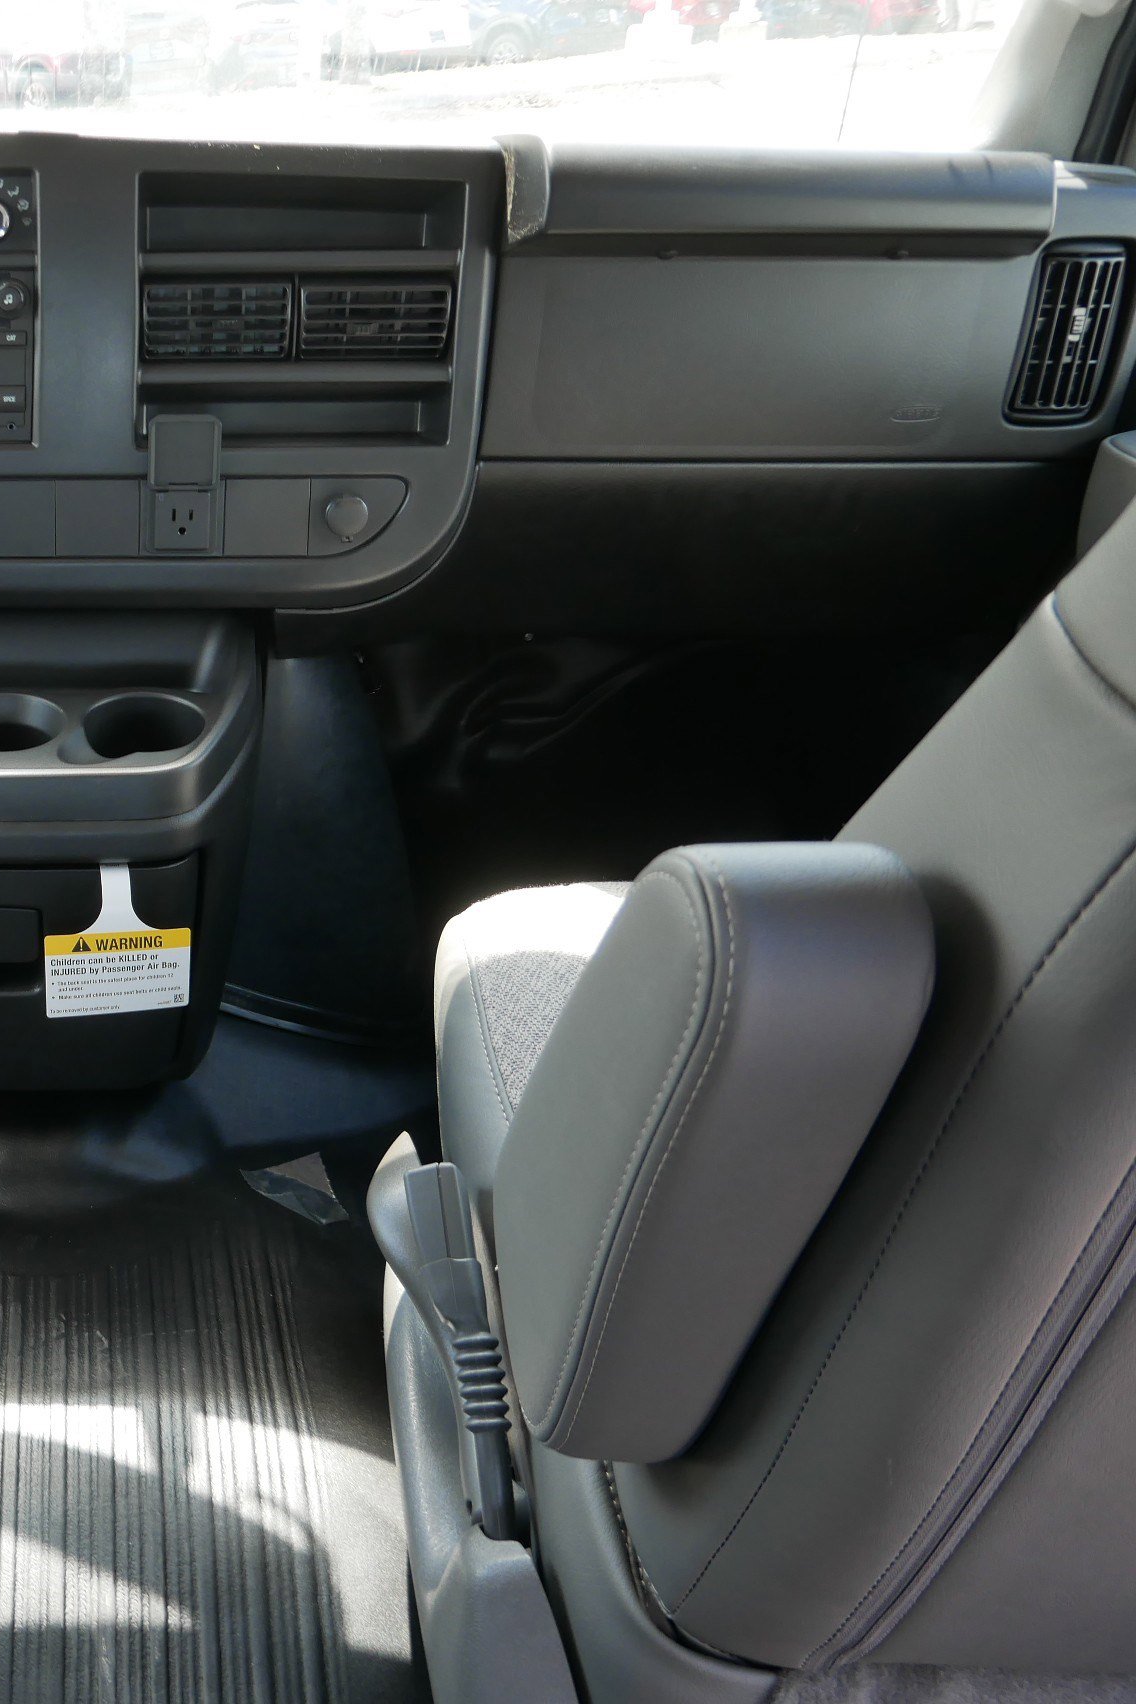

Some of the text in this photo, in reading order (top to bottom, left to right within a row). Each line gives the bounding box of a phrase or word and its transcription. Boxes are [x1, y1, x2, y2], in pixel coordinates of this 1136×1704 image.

[95, 935, 163, 951] WARNING
[50, 957, 85, 966] Children
[118, 953, 148, 962] KILLED
[51, 961, 180, 976] INJURED by Passenger Air Bag.
